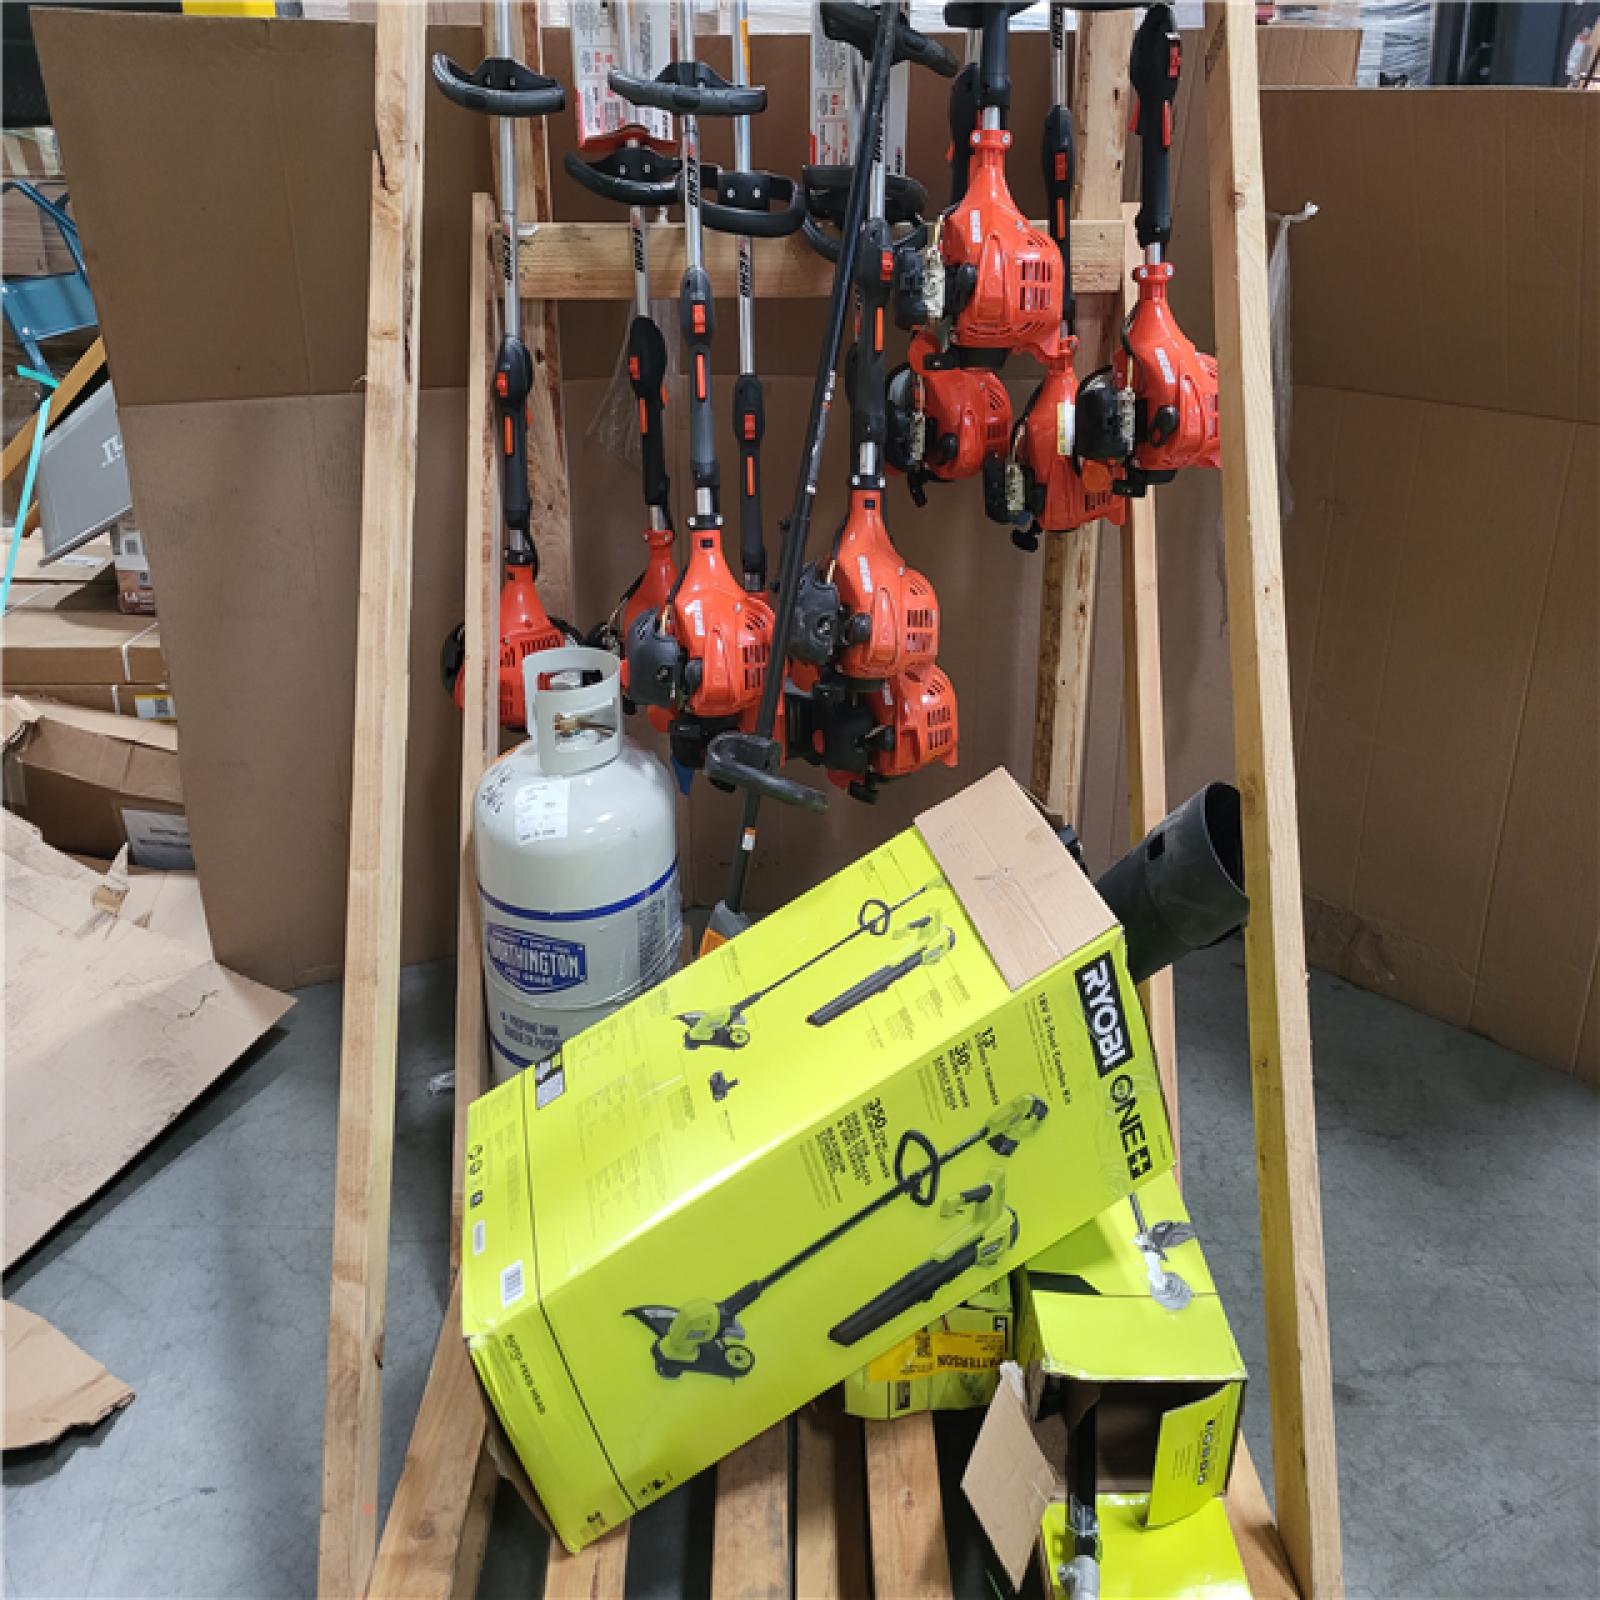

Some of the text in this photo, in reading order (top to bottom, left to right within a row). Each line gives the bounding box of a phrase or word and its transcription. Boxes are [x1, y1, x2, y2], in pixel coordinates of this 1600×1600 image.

[687, 156, 699, 208] ECHO
[502, 233, 513, 281] ECHO
[634, 227, 646, 273] ECHO
[738, 249, 752, 298] ECHO
[489, 932, 580, 979] WORTHINGTON
[1081, 958, 1127, 1070] RYOBI
[937, 1354, 1003, 1369] PATTERSON
